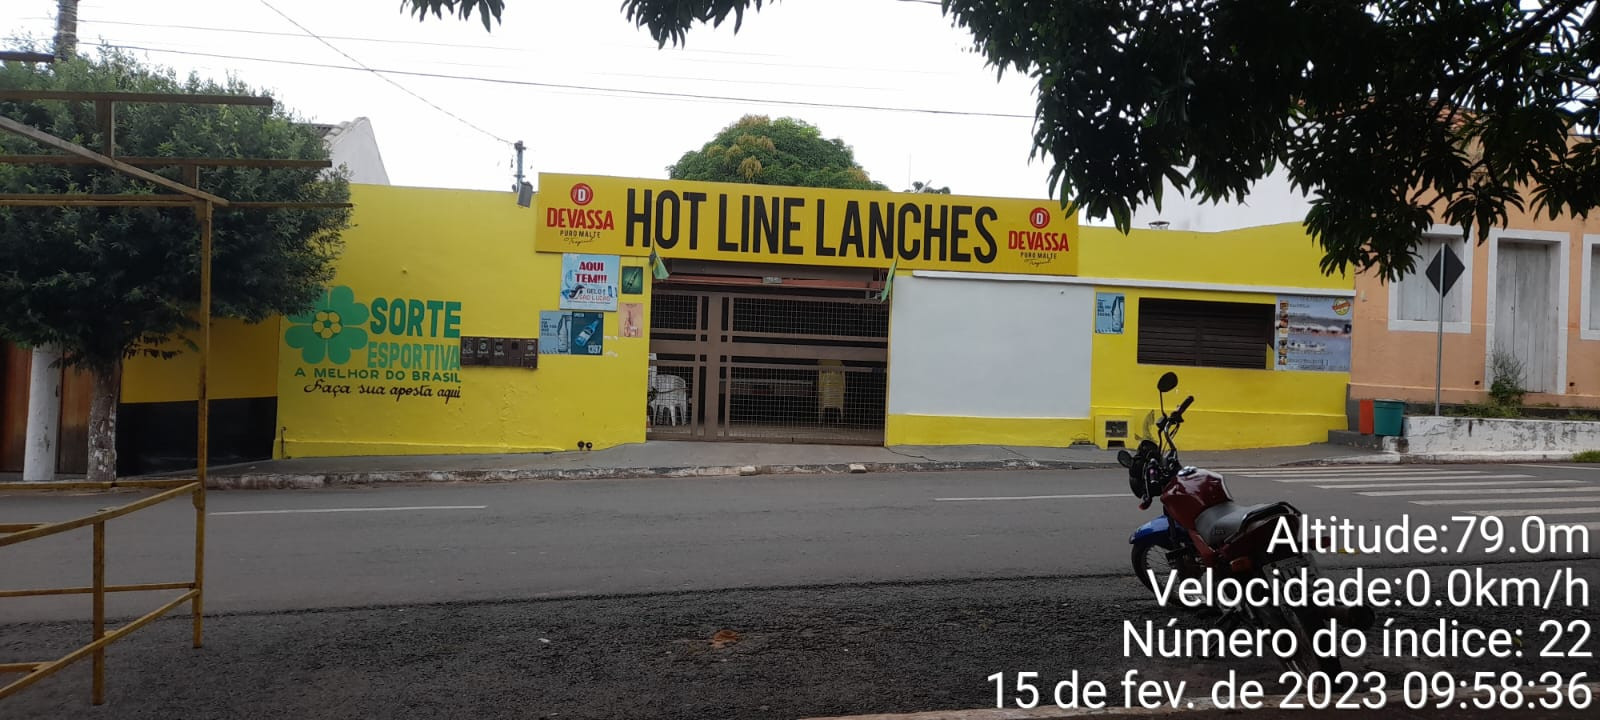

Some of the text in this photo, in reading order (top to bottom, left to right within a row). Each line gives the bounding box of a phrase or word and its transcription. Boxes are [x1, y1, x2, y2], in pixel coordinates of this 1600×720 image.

[546, 207, 615, 231] DEVASSA
[625, 188, 998, 264] HOT LINE LANCHES
[578, 230, 601, 239] MALTE
[1008, 230, 1069, 252] DEVASSA
[579, 261, 604, 271] AQUI
[575, 273, 607, 284] TEM!!!
[370, 297, 461, 338] SORTE
[367, 342, 461, 371] ESPORTIVA
[294, 368, 461, 383] A MELHOR DO BRASIL
[303, 379, 461, 404] Faça sua aposta aqui
